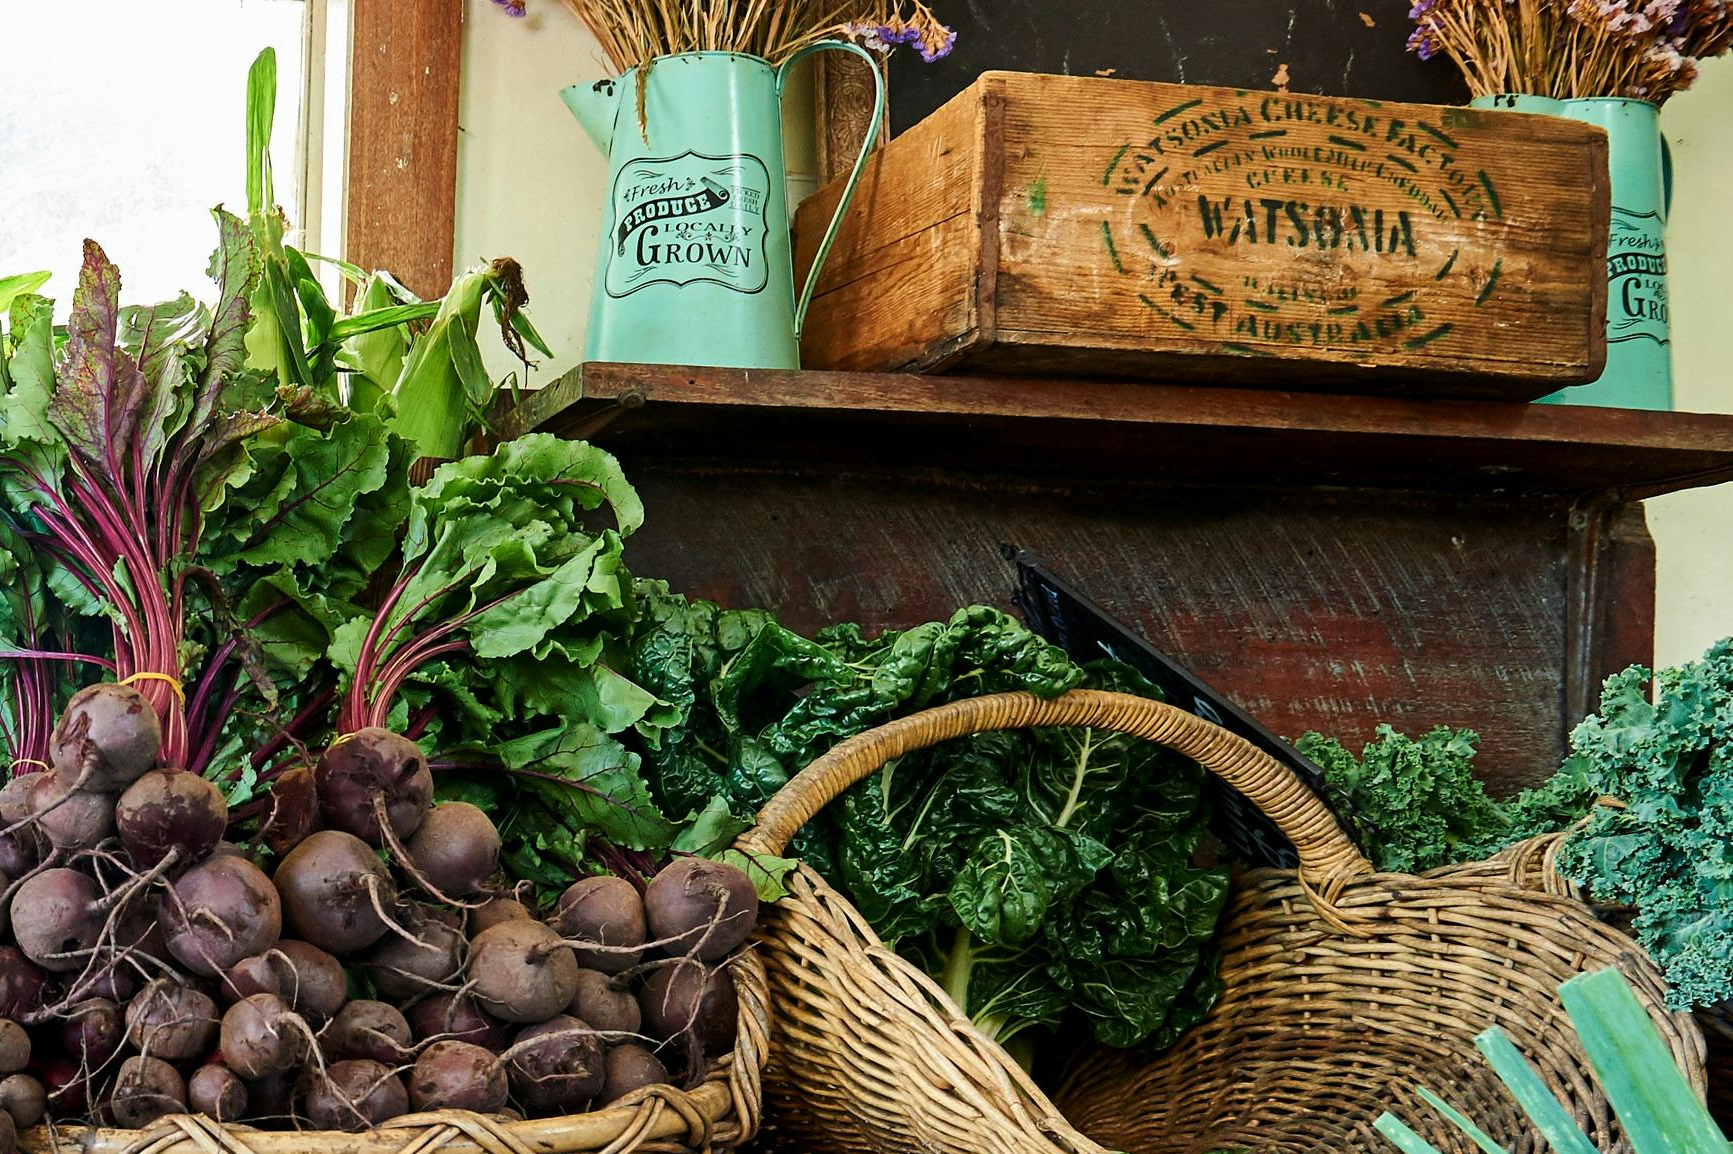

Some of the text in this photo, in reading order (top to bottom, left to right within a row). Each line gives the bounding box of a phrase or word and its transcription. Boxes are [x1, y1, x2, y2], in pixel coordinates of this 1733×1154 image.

[1260, 98, 1380, 137] CHEESE
[1385, 118, 1489, 221] FACTORY
[630, 177, 683, 202] Fresh
[624, 194, 711, 231] PRODUCE
[664, 221, 753, 236] LOCALLY
[1198, 194, 1416, 257] WATSONIA
[636, 224, 752, 267] GROWN
